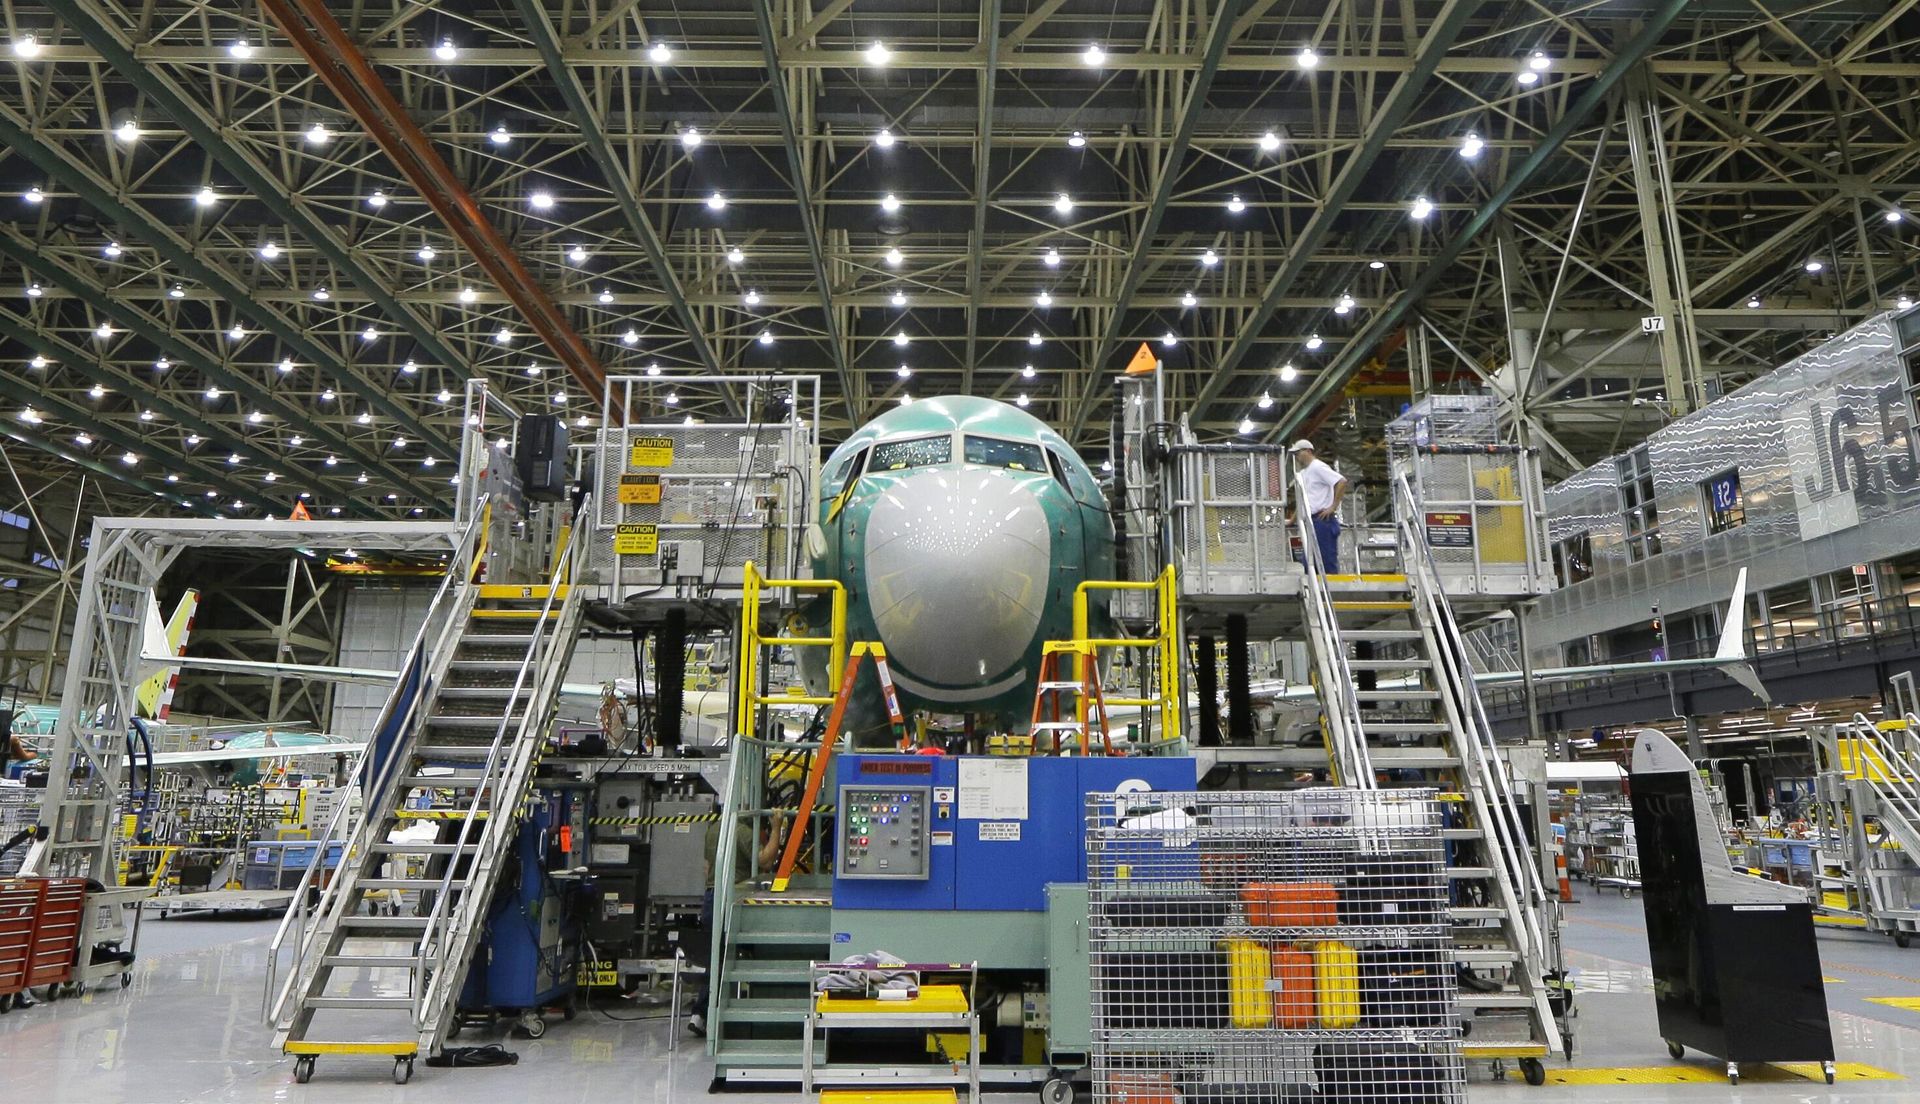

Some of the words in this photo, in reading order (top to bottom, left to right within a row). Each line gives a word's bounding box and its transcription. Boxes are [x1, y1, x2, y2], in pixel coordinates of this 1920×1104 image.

[1644, 318, 1661, 330] J7
[636, 439, 671, 447] CAUTION
[1718, 481, 1732, 508] 12
